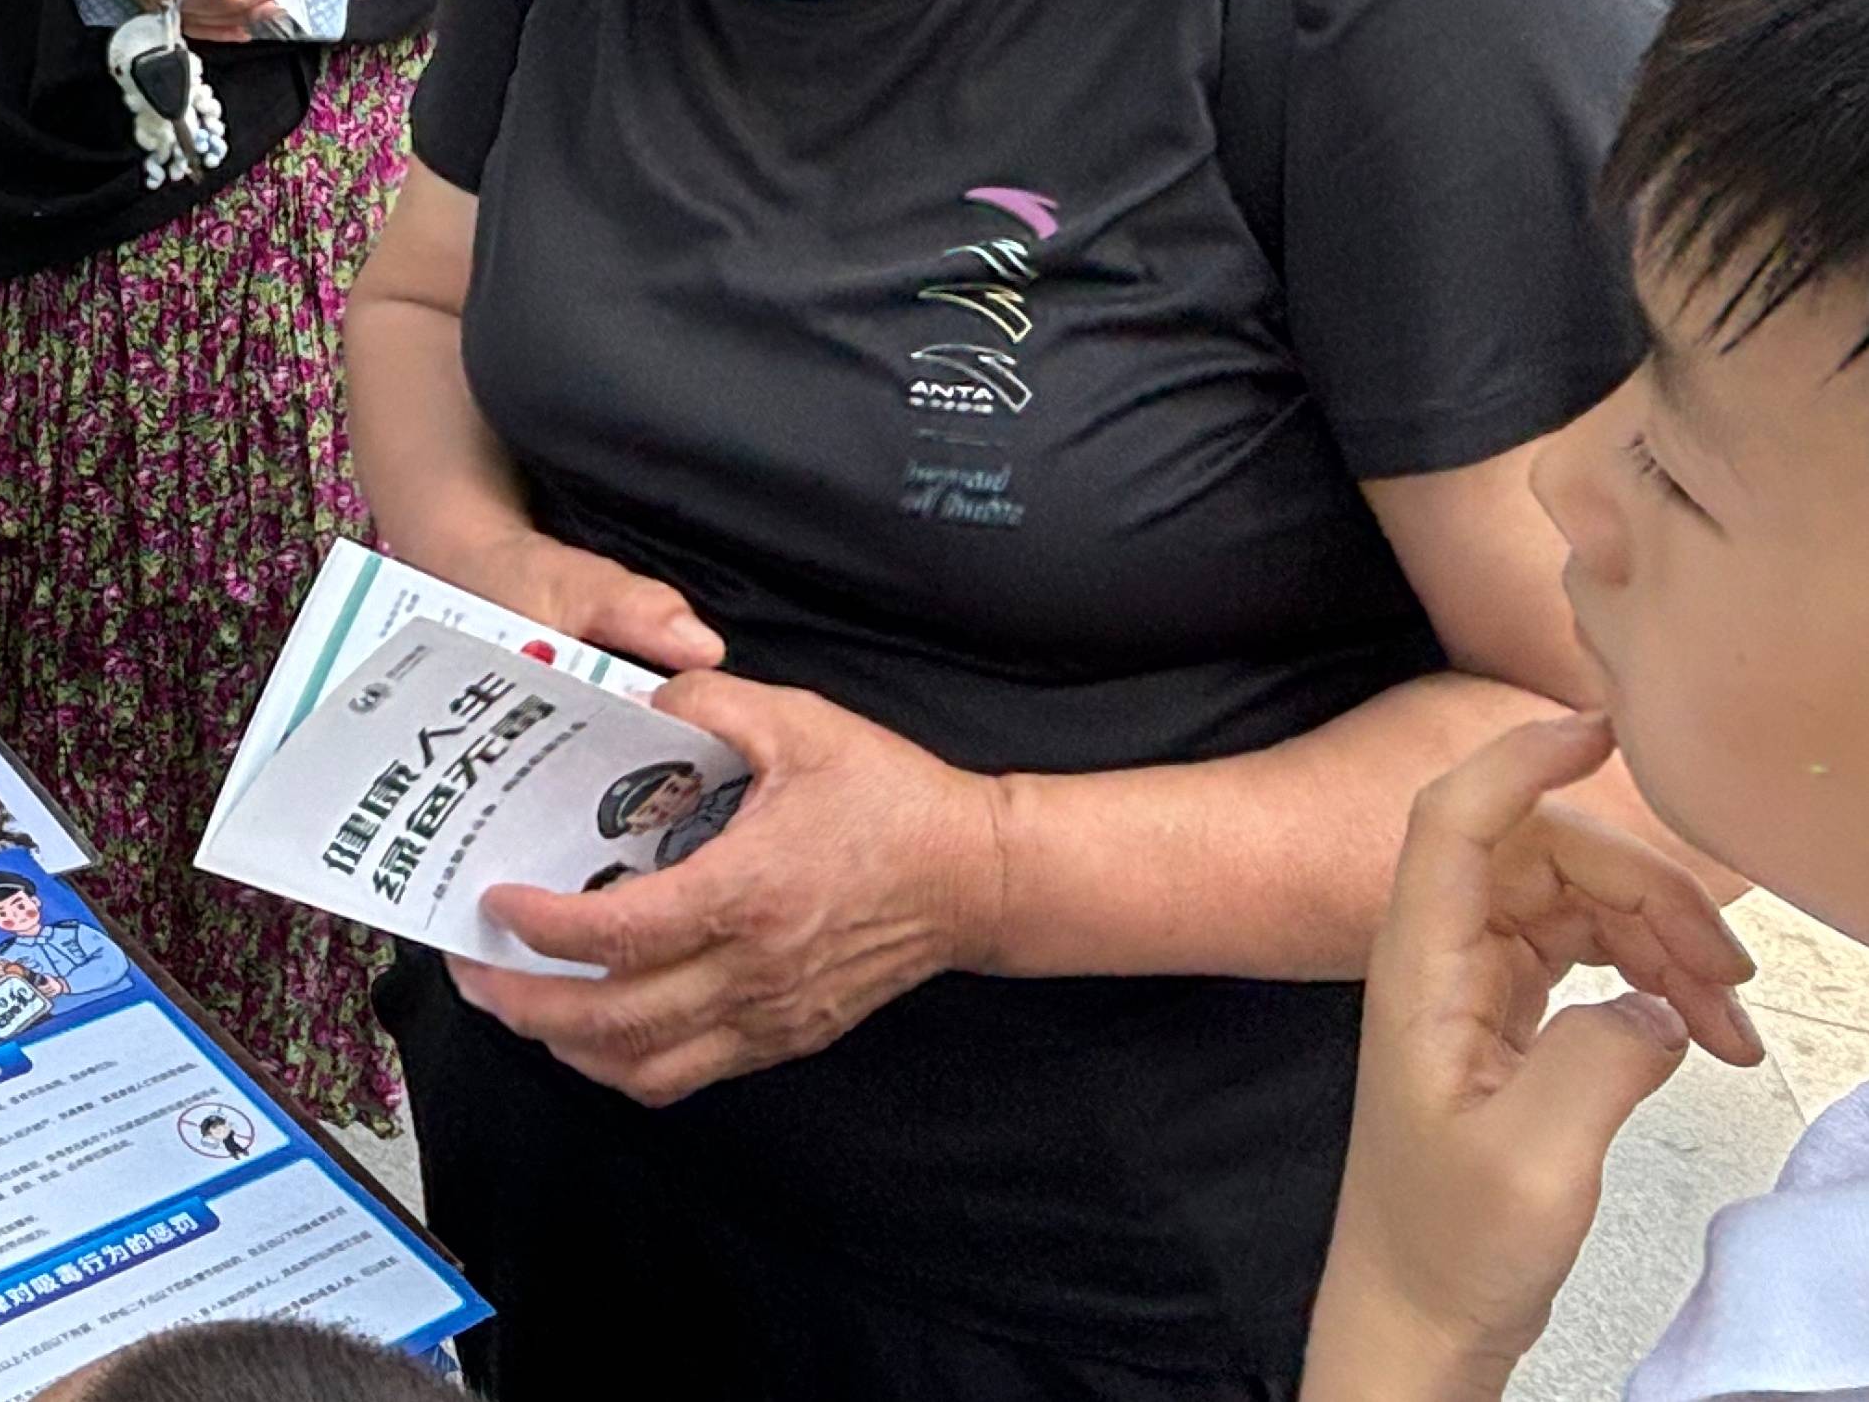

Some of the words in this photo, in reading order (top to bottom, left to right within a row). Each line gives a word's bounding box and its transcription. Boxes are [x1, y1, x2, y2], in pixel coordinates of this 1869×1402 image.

[910, 380, 995, 400] ANTA
[321, 671, 518, 876] 健康人生
[370, 693, 558, 905] 绿色无毒
